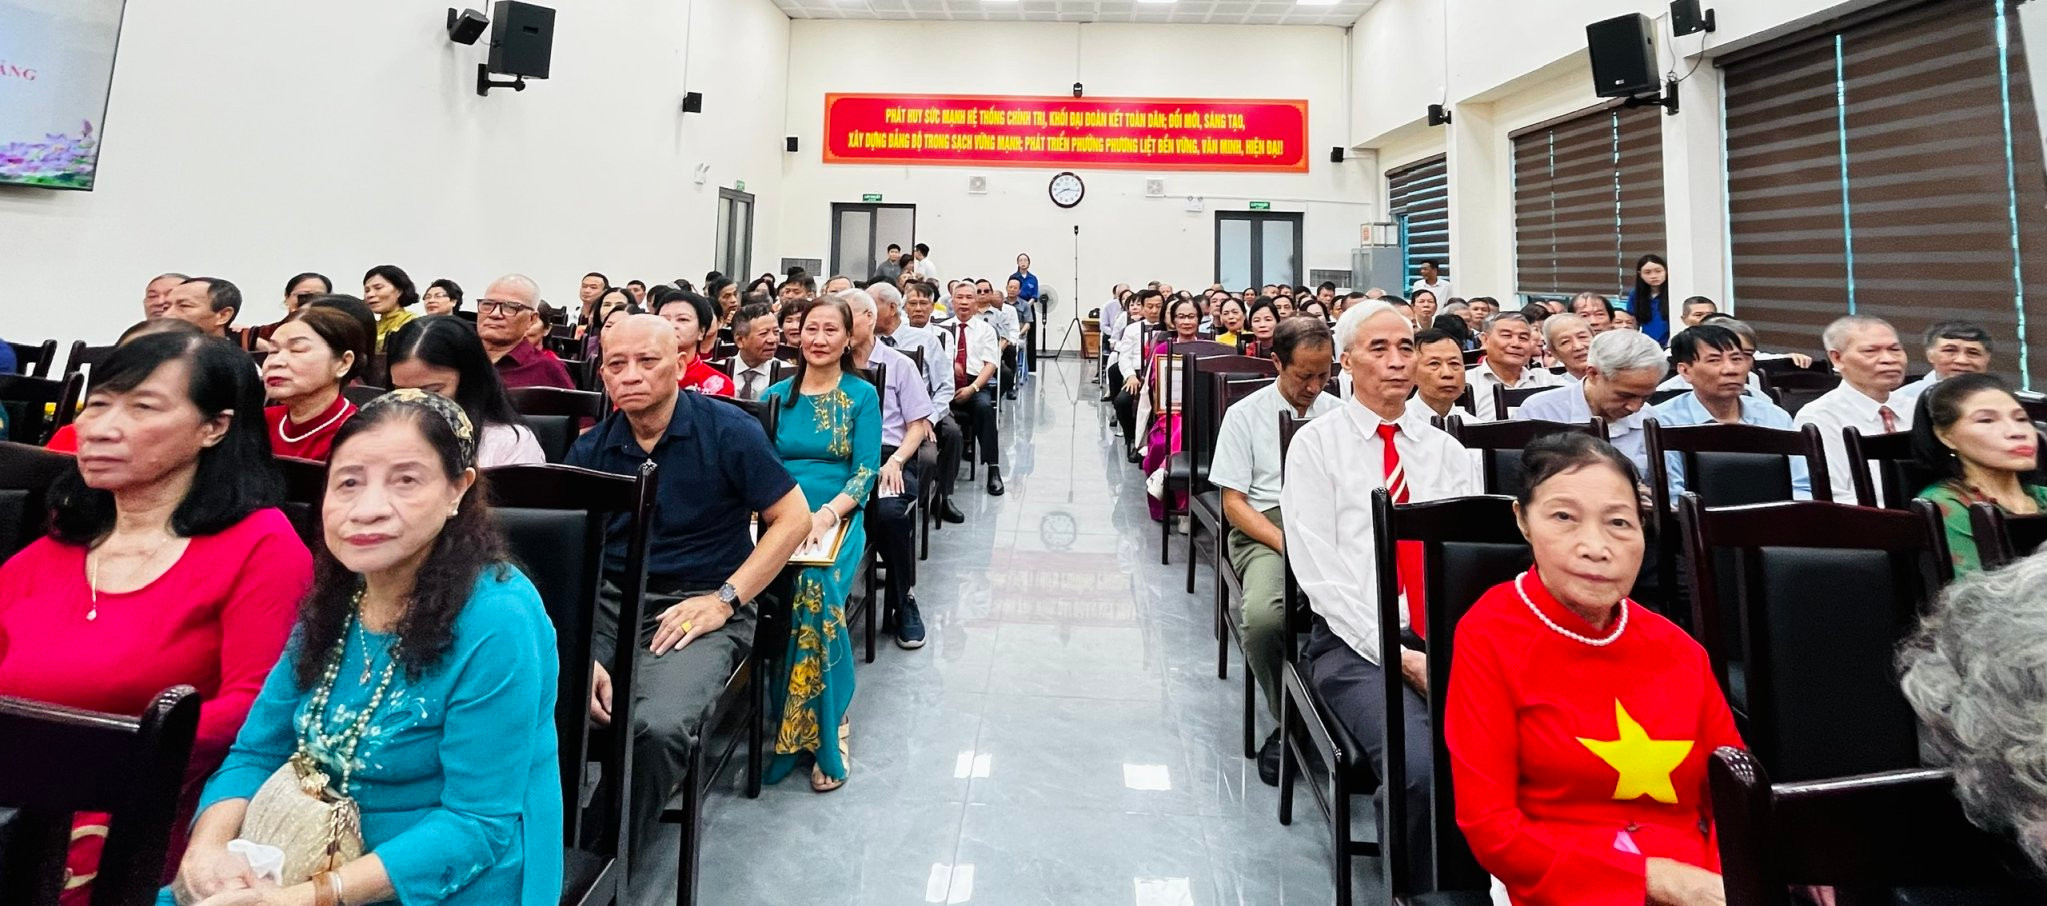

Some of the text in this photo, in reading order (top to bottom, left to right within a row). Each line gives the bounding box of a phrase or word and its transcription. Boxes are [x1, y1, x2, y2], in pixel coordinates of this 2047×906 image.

[885, 105, 906, 124] PHÁT
[907, 108, 923, 124] HUY
[924, 106, 940, 124] SỨC
[942, 109, 966, 127] MẠNH
[967, 107, 978, 128] HỆ
[980, 105, 1005, 125] THỐNG
[1007, 108, 1031, 125] CHÍNH
[1049, 107, 1068, 126] KHỐI
[1109, 108, 1124, 127] KẾT
[1125, 109, 1146, 127] TOÀN
[1204, 111, 1226, 128] SÁNG
[848, 129, 864, 148] XÂY
[912, 130, 923, 152] BỘ
[924, 133, 950, 149] TRONG
[951, 134, 973, 152] SẠCH
[1025, 133, 1046, 151] PHÁT
[1047, 130, 1070, 151] TRIỂN
[1245, 137, 1265, 158] HIỆN
